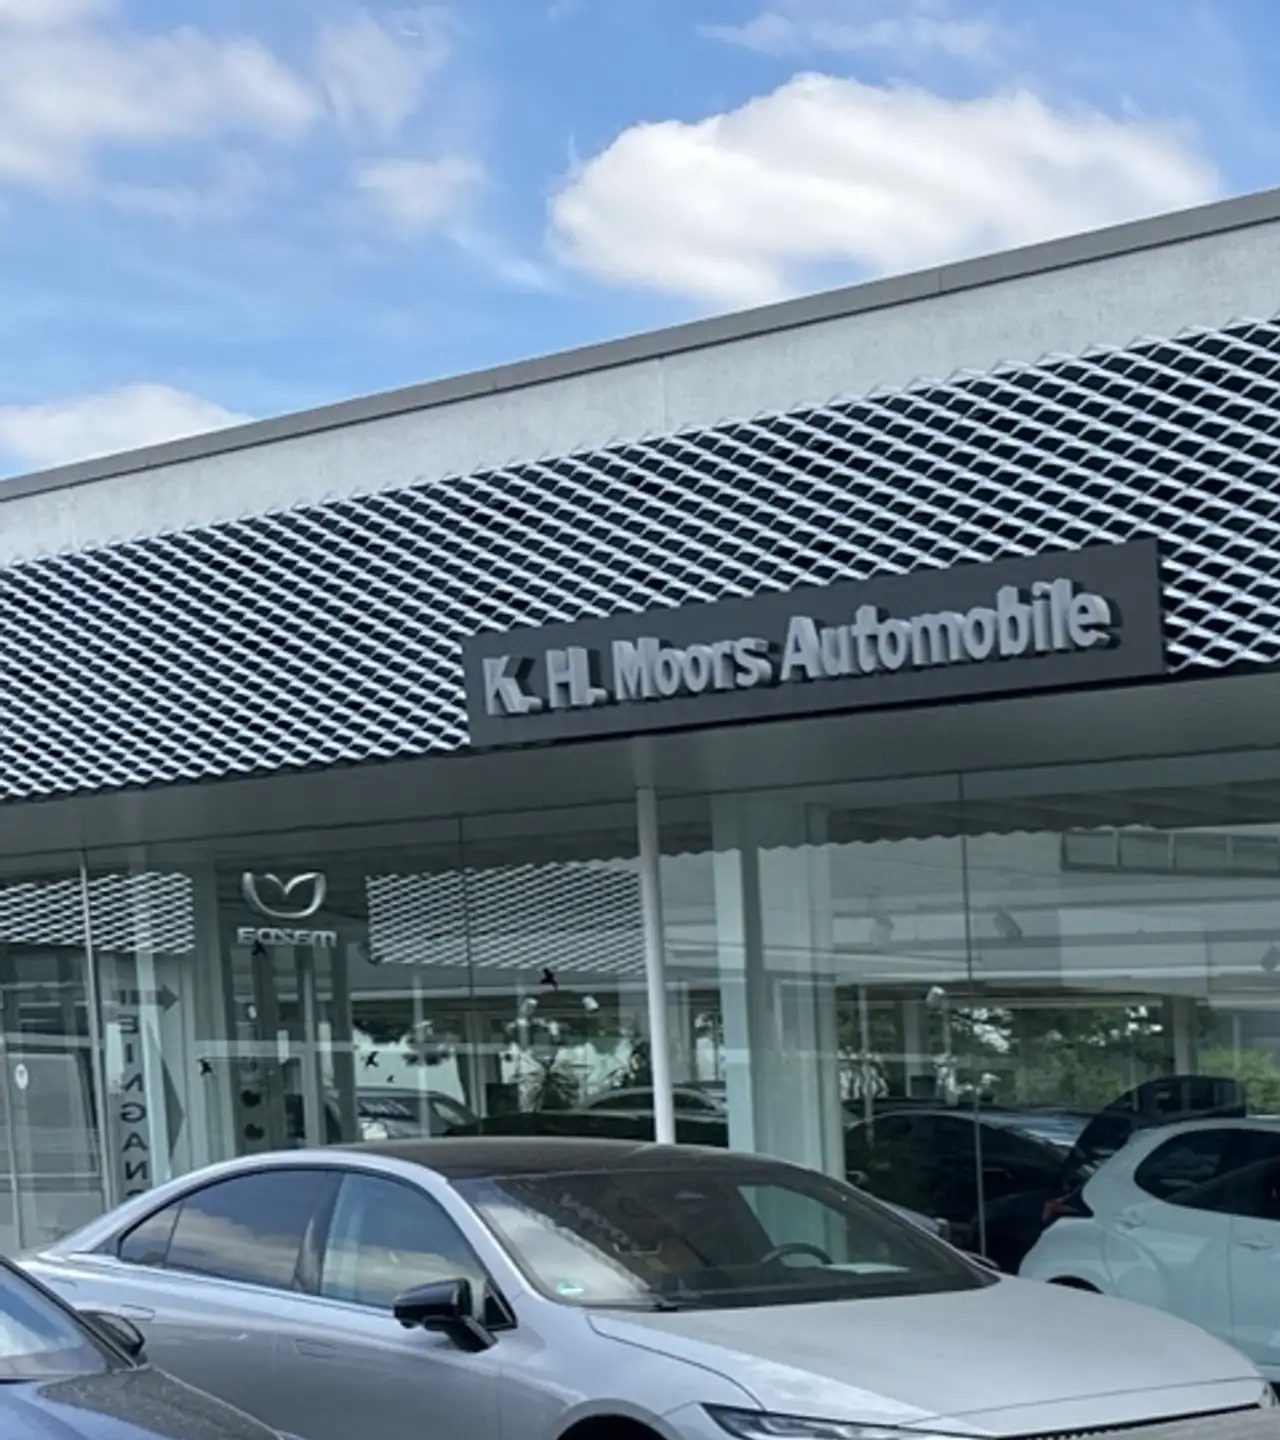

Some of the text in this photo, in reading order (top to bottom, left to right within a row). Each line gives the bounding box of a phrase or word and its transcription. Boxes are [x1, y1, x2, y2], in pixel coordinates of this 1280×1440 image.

[483, 578, 1111, 716] K. H. Moors Automobile
